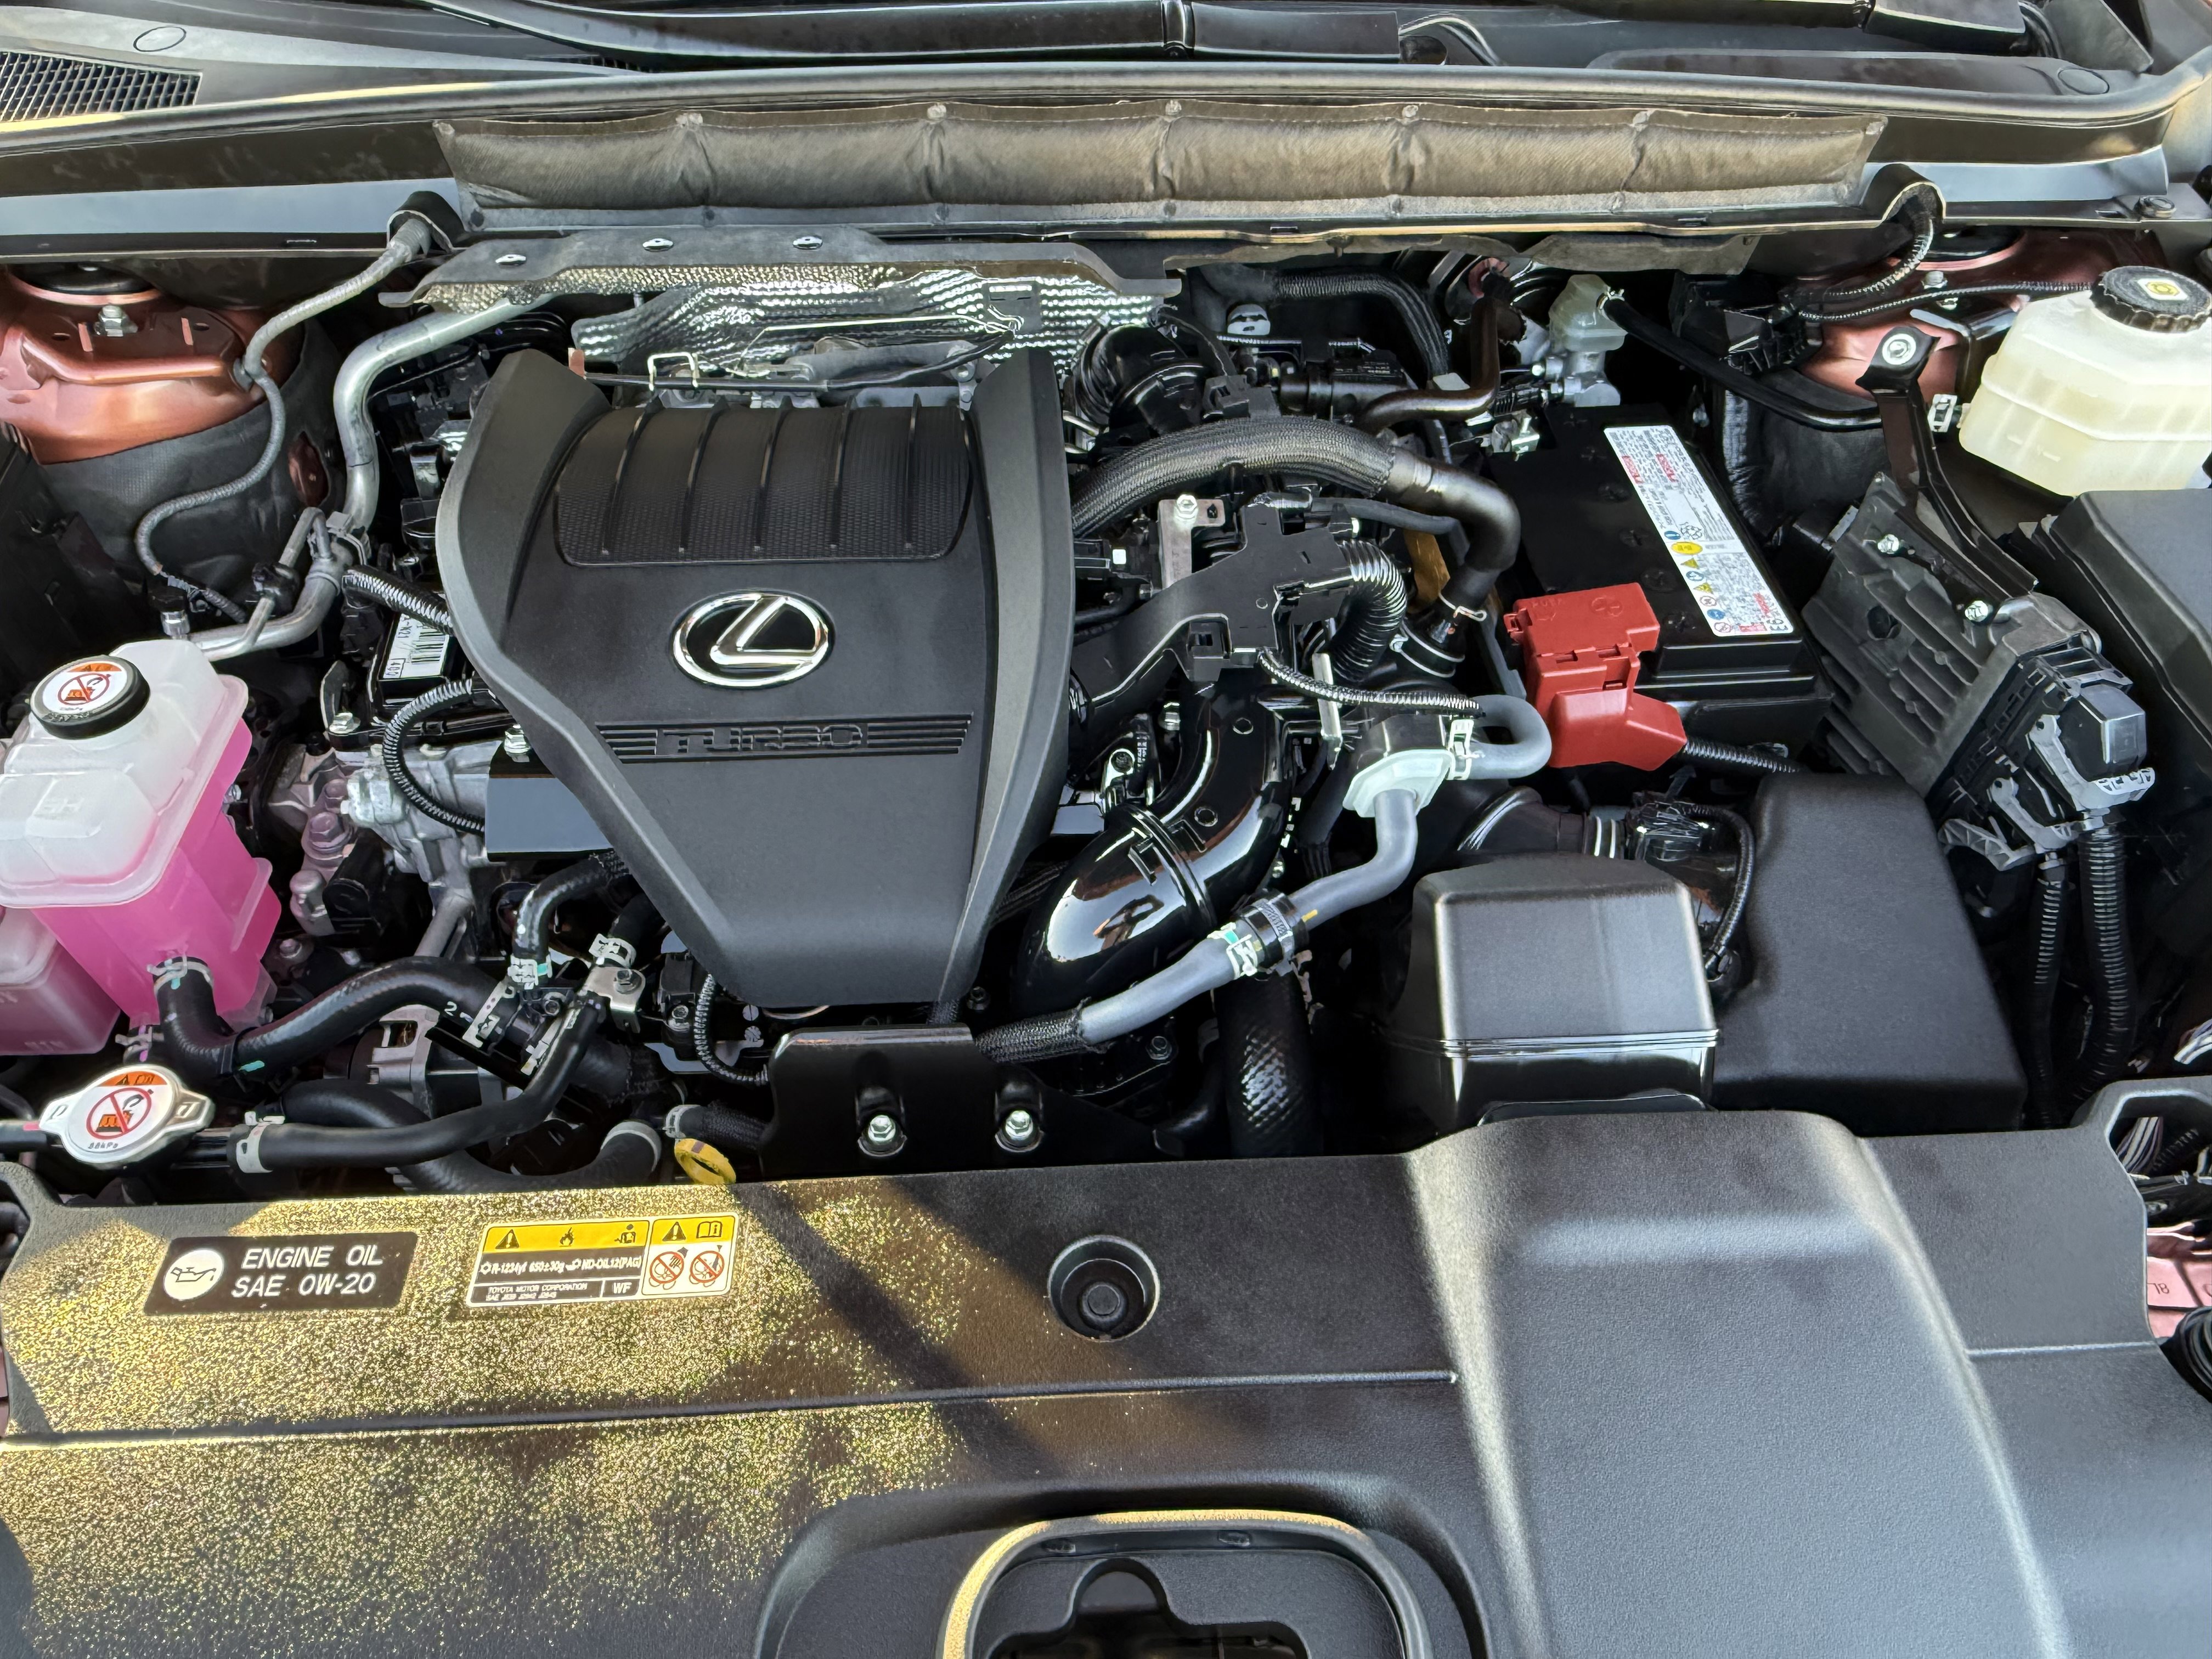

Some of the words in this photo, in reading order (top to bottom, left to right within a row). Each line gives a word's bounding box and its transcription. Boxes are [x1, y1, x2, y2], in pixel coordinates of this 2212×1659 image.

[663, 724, 864, 752] TURBO
[240, 1245, 334, 1269] ENGINE
[346, 1244, 383, 1266] OIL
[231, 1274, 286, 1298] SAE
[298, 1272, 376, 1296] 0W-20
[541, 1283, 588, 1291] CORPORATION
[613, 1282, 632, 1294] WF
